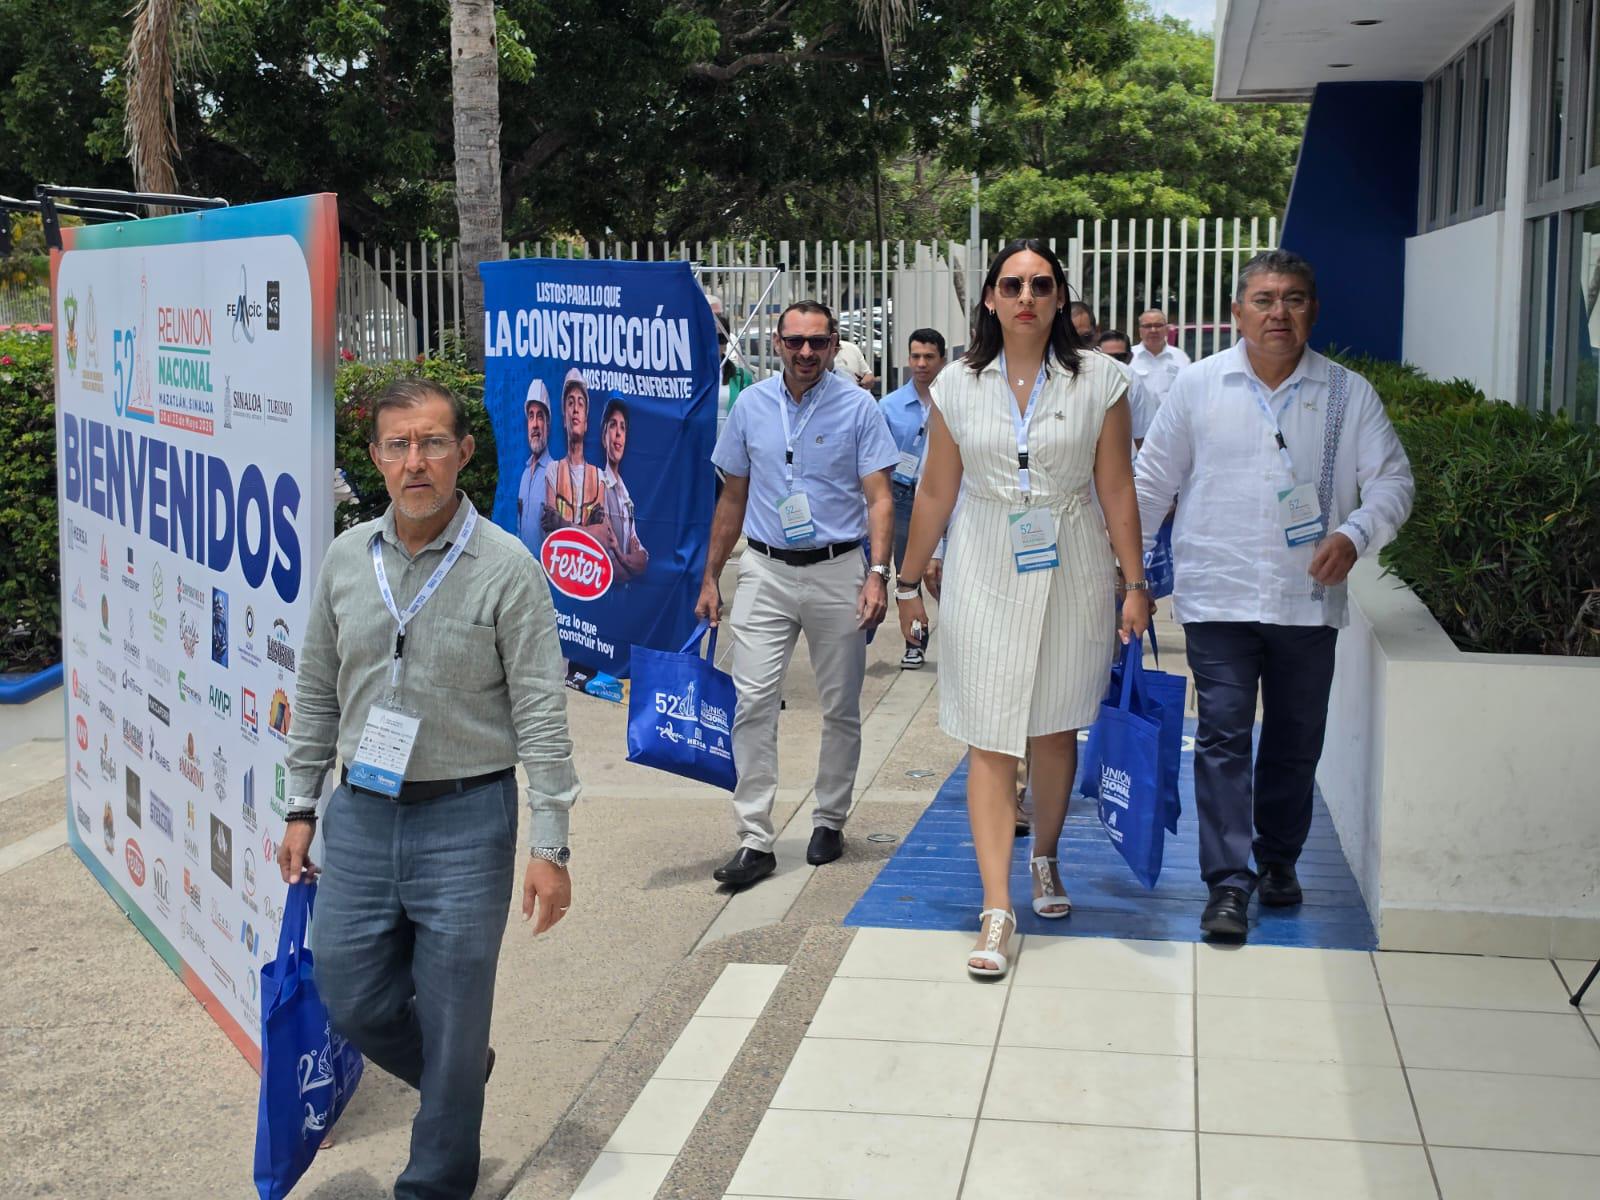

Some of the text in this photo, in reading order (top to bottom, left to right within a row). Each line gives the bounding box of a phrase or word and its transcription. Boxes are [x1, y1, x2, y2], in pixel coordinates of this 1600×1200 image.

[536, 282, 622, 308] LISTOS PARA LO QUE
[484, 305, 692, 371] LA CONSTRUCCIÓN
[158, 356, 213, 393] NACIONAL
[583, 369, 693, 399] NOS PONGA ENFRENTE
[189, 397, 214, 415] SINALOA
[233, 390, 262, 413] SINALOA
[267, 398, 293, 417] TURISMO
[64, 412, 302, 604] BIENVENIDOS
[549, 540, 604, 590] Fester
[572, 613, 581, 630] lo
[581, 620, 597, 637] que
[559, 627, 615, 660] construir hoy
[208, 684, 231, 717] AMPI
[1101, 765, 1132, 787] UNIÓN
[1101, 779, 1131, 799] CIONAL
